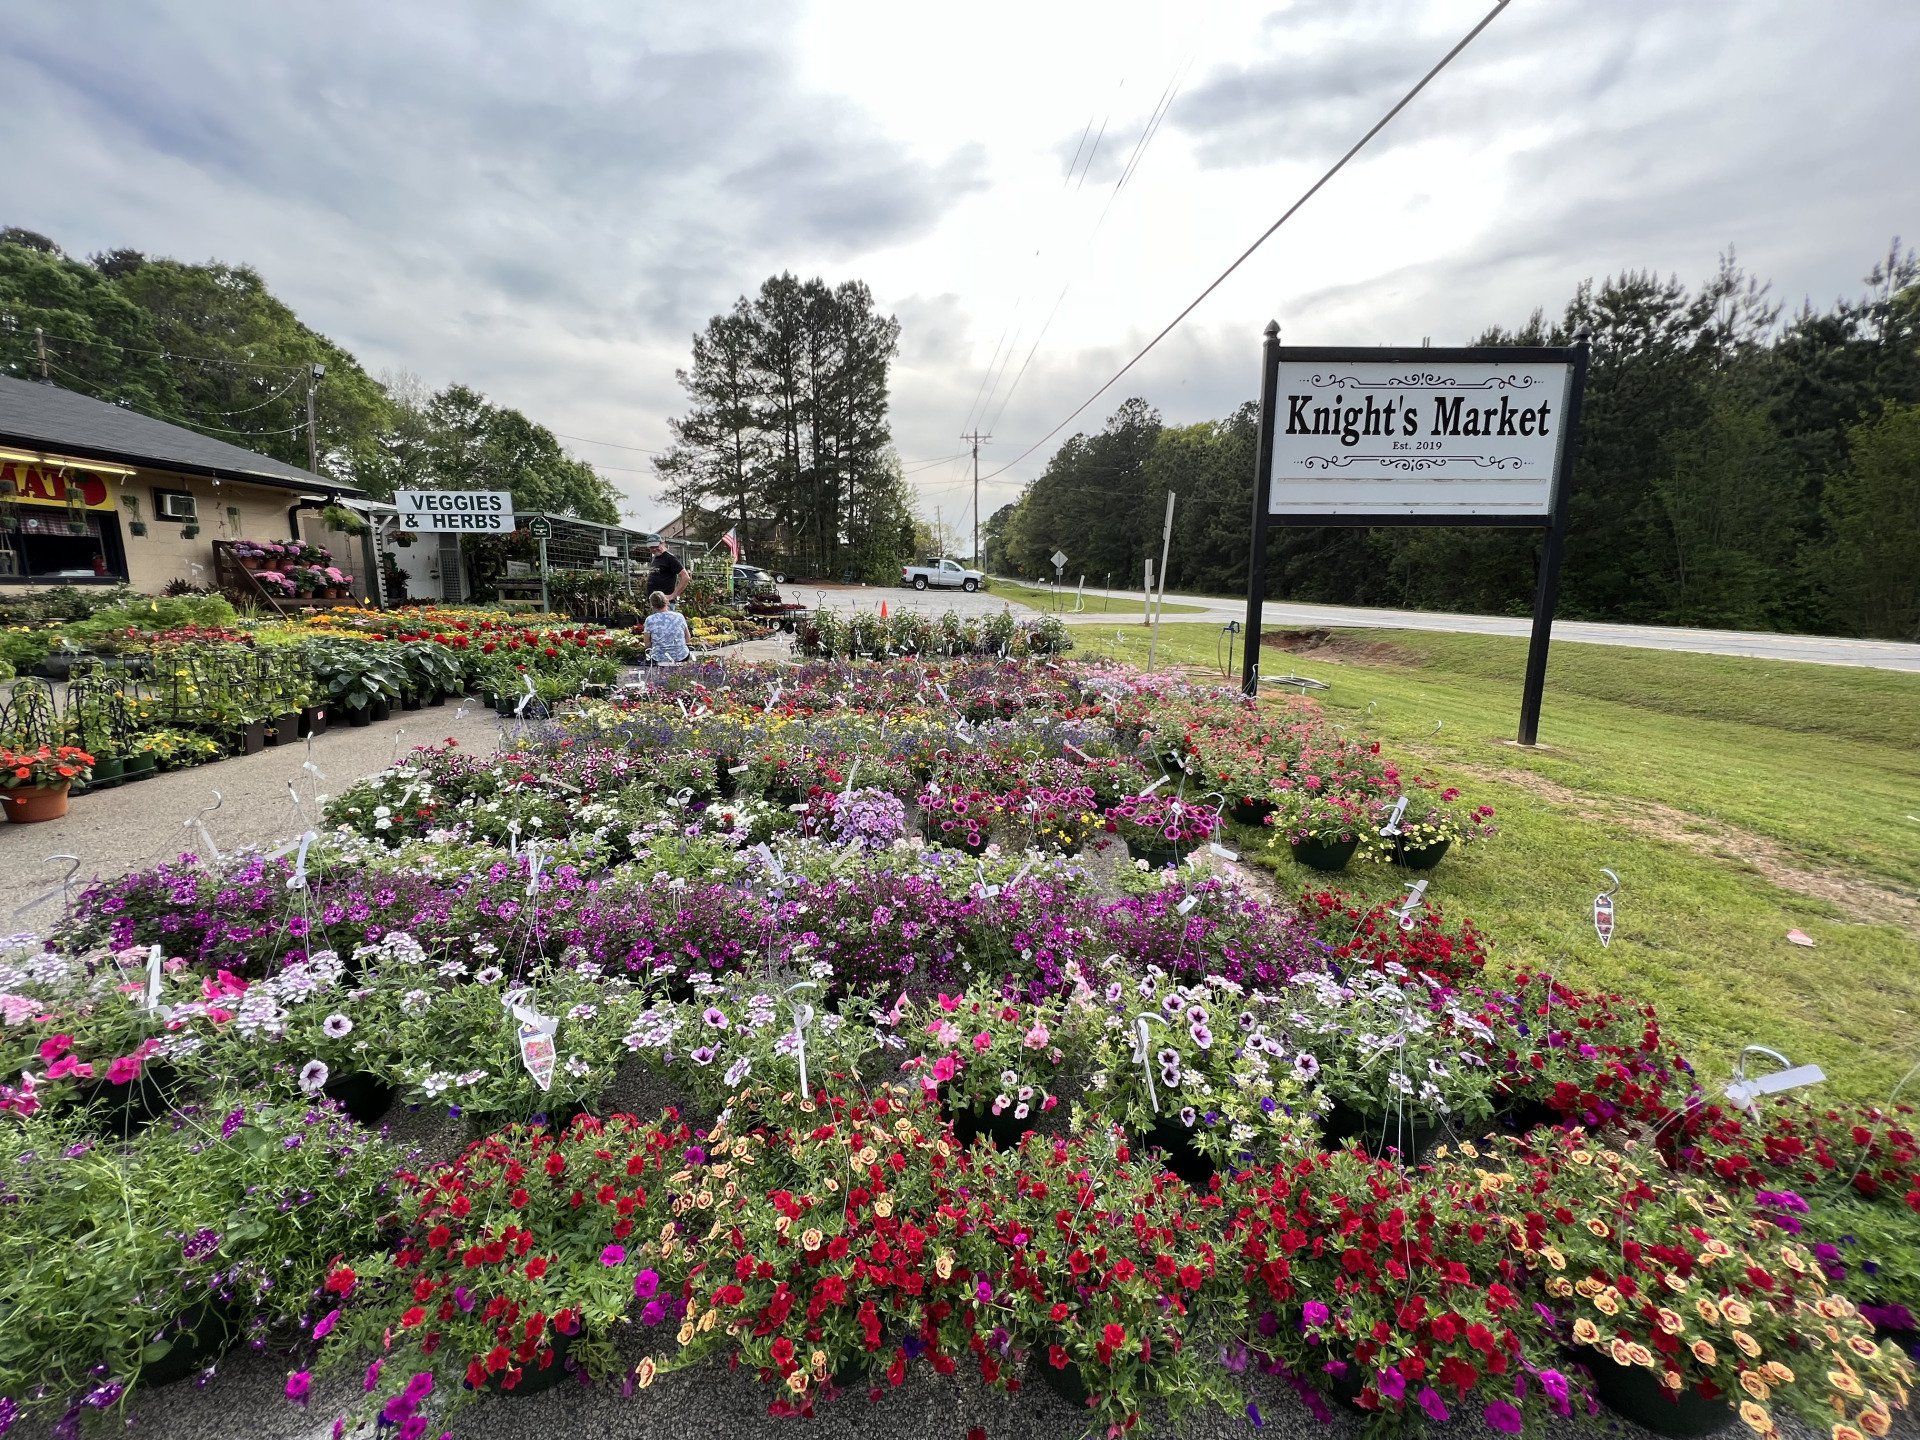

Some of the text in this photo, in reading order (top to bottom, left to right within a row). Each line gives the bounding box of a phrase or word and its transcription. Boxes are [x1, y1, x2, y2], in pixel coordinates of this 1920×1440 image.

[1285, 395, 1551, 446] Knight's Market
[1392, 441, 1443, 450] Est. 2019
[410, 494, 502, 512] VEGGIES
[405, 513, 501, 529] & HERBS
